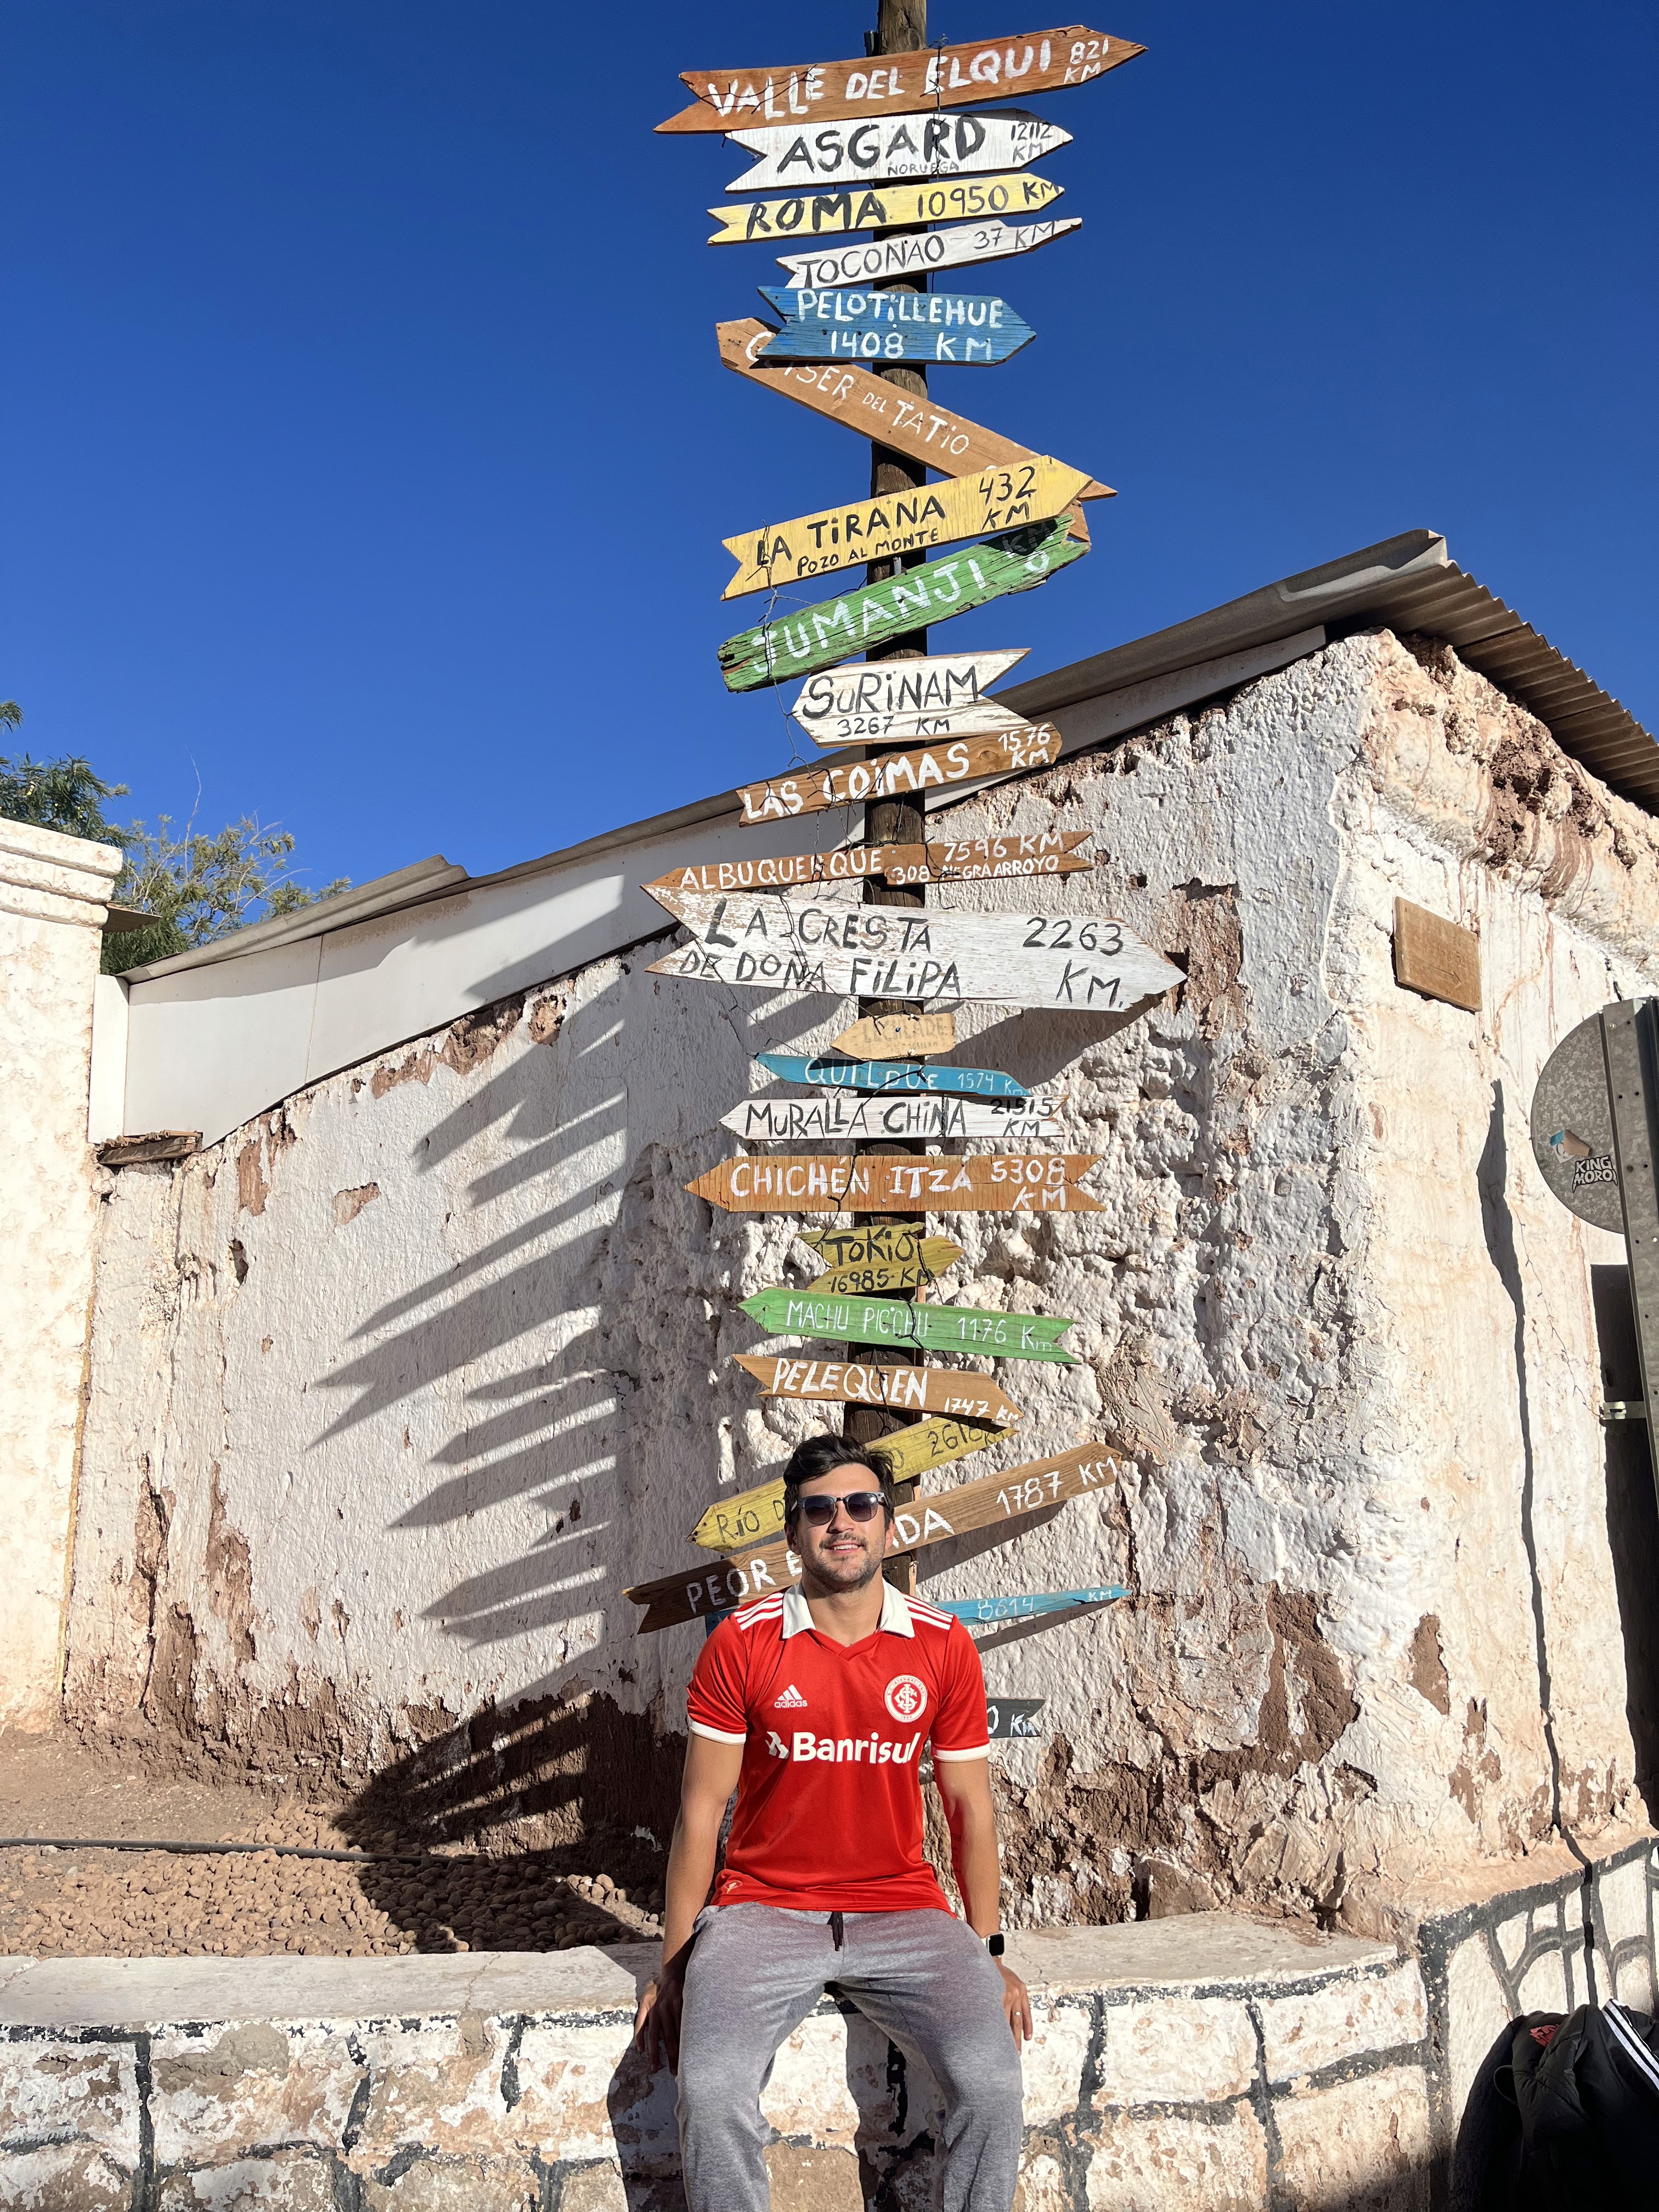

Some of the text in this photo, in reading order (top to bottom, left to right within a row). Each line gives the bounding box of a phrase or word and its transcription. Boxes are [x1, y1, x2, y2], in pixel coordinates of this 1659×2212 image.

[1070, 39, 1109, 66] 821
[707, 39, 1051, 120] VALLE DEL ELQUI
[1063, 63, 1102, 84] KM
[776, 114, 987, 173] ASGARD
[1010, 120, 1052, 142] 12112
[1012, 141, 1044, 161] KM
[887, 161, 960, 176] NORUEGA
[746, 181, 1060, 240] ROMA 10950 KM
[796, 221, 1055, 288] TOCONAO 37 KM
[830, 330, 992, 361] 1408 KM
[746, 331, 854, 400] GSER
[862, 392, 887, 413] DEL
[979, 466, 1037, 505] 432
[981, 501, 1029, 532] KM
[757, 535, 793, 567] LA
[797, 527, 939, 577] POZO AL MONTE
[751, 558, 986, 673] JUMANJI
[838, 715, 950, 737] 3267 KM
[998, 723, 1051, 752] 1576
[1012, 747, 1049, 769] KM
[743, 780, 804, 820] LAS
[680, 833, 1064, 890] ALBUQUERQUE 7596 KM
[892, 865, 930, 885] 308
[705, 899, 1125, 956] LA CRESTA 2263
[679, 950, 723, 978] DE
[736, 950, 827, 992] DOÑA
[958, 1072, 994, 1092] 1574
[990, 1097, 1054, 1116] 21515
[1003, 1118, 1040, 1137] KM
[730, 1155, 1066, 1199] CHICHÉN ITZÁ 5308
[1573, 1169, 1615, 1189] MORO
[1575, 1156, 1612, 1173] KING
[1012, 1186, 1066, 1211] KM
[831, 1268, 889, 1293] 16985
[786, 1300, 849, 1330] MACHU
[862, 1307, 929, 1338] PICCHU
[957, 1316, 1007, 1344] 1176
[772, 1357, 929, 1407] PELEQUEN
[944, 1396, 991, 1416] 1747
[773, 1500, 785, 1521] D
[687, 1457, 1118, 1614] PEOR E DA 1787 KM
[978, 1589, 1113, 1620] 8614 KM
[774, 1699, 808, 1708] adidas
[793, 1732, 921, 1764] Banrisul
